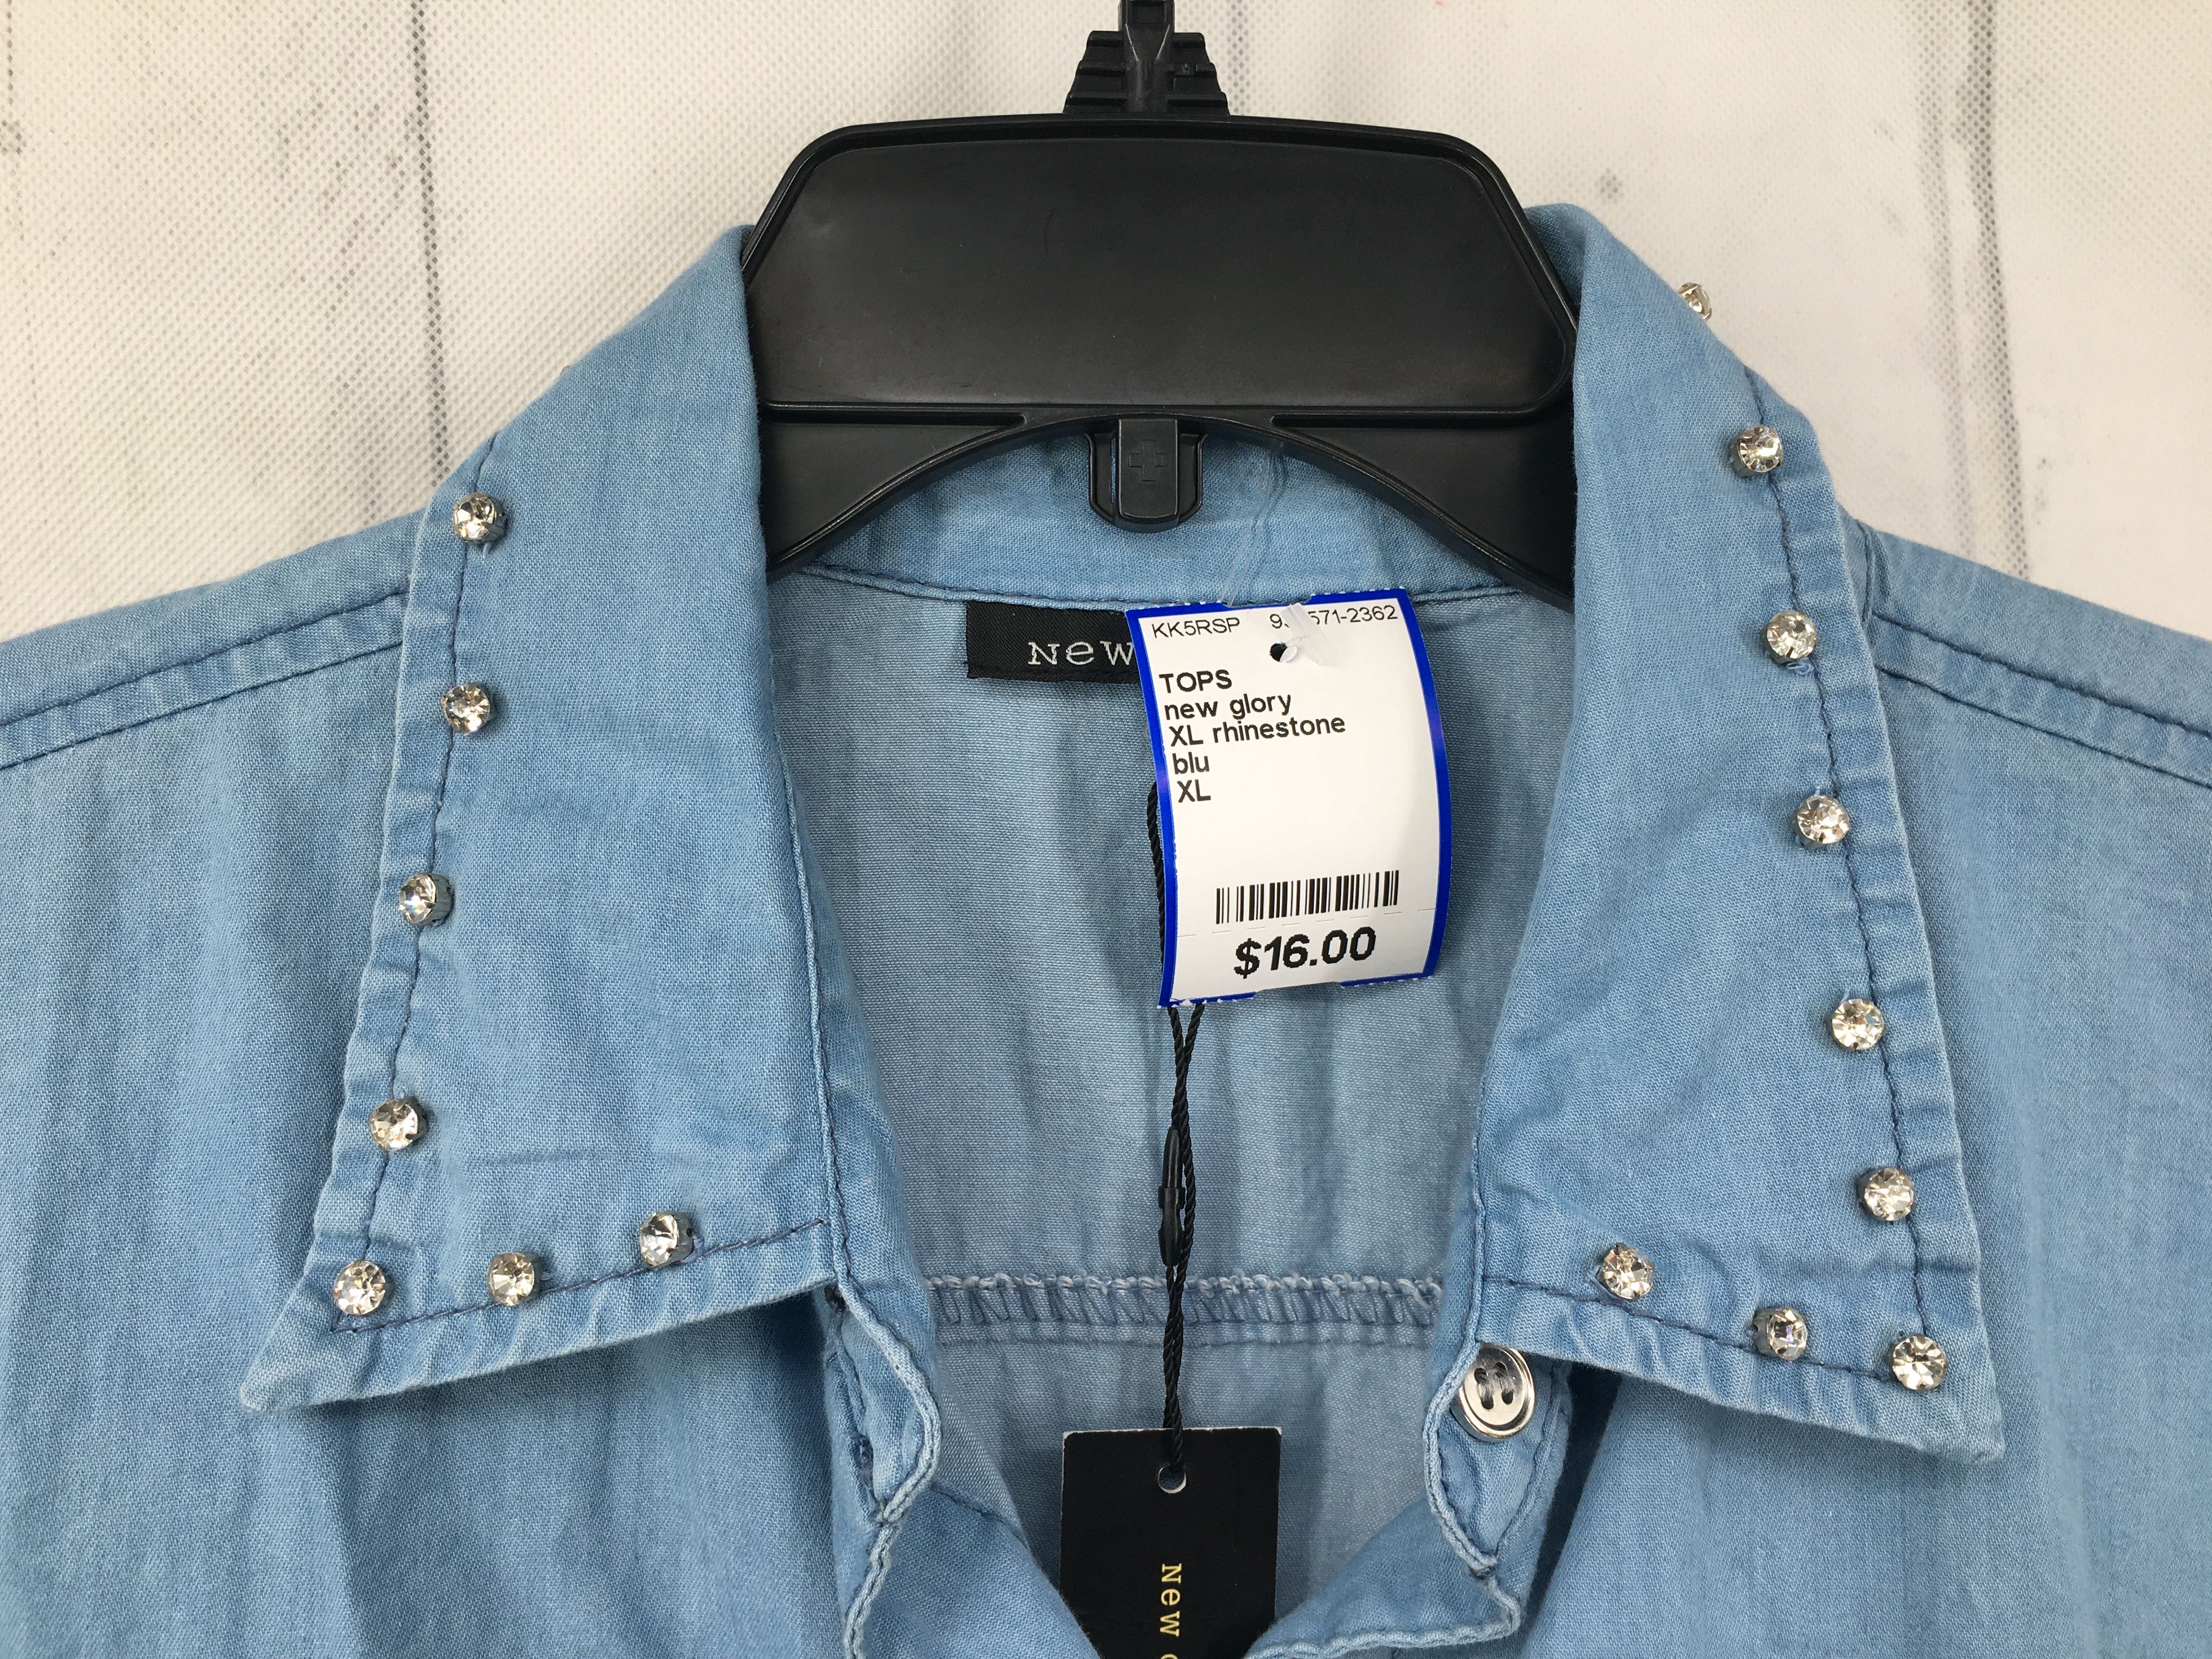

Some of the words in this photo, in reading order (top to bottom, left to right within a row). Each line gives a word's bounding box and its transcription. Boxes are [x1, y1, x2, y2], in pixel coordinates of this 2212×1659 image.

[1152, 617, 1240, 639] KK5RSP
[1028, 641, 1133, 665] New
[1159, 669, 1232, 693] TOPS
[1164, 701, 1218, 720] new
[1229, 693, 1291, 720] glory
[1169, 725, 1204, 747] XL
[1212, 717, 1346, 743] rhinestone
[1172, 752, 1210, 775] blu
[1177, 779, 1211, 803] XL
[1233, 926, 1376, 979] $16.00
[1159, 1563, 1182, 1637] New
